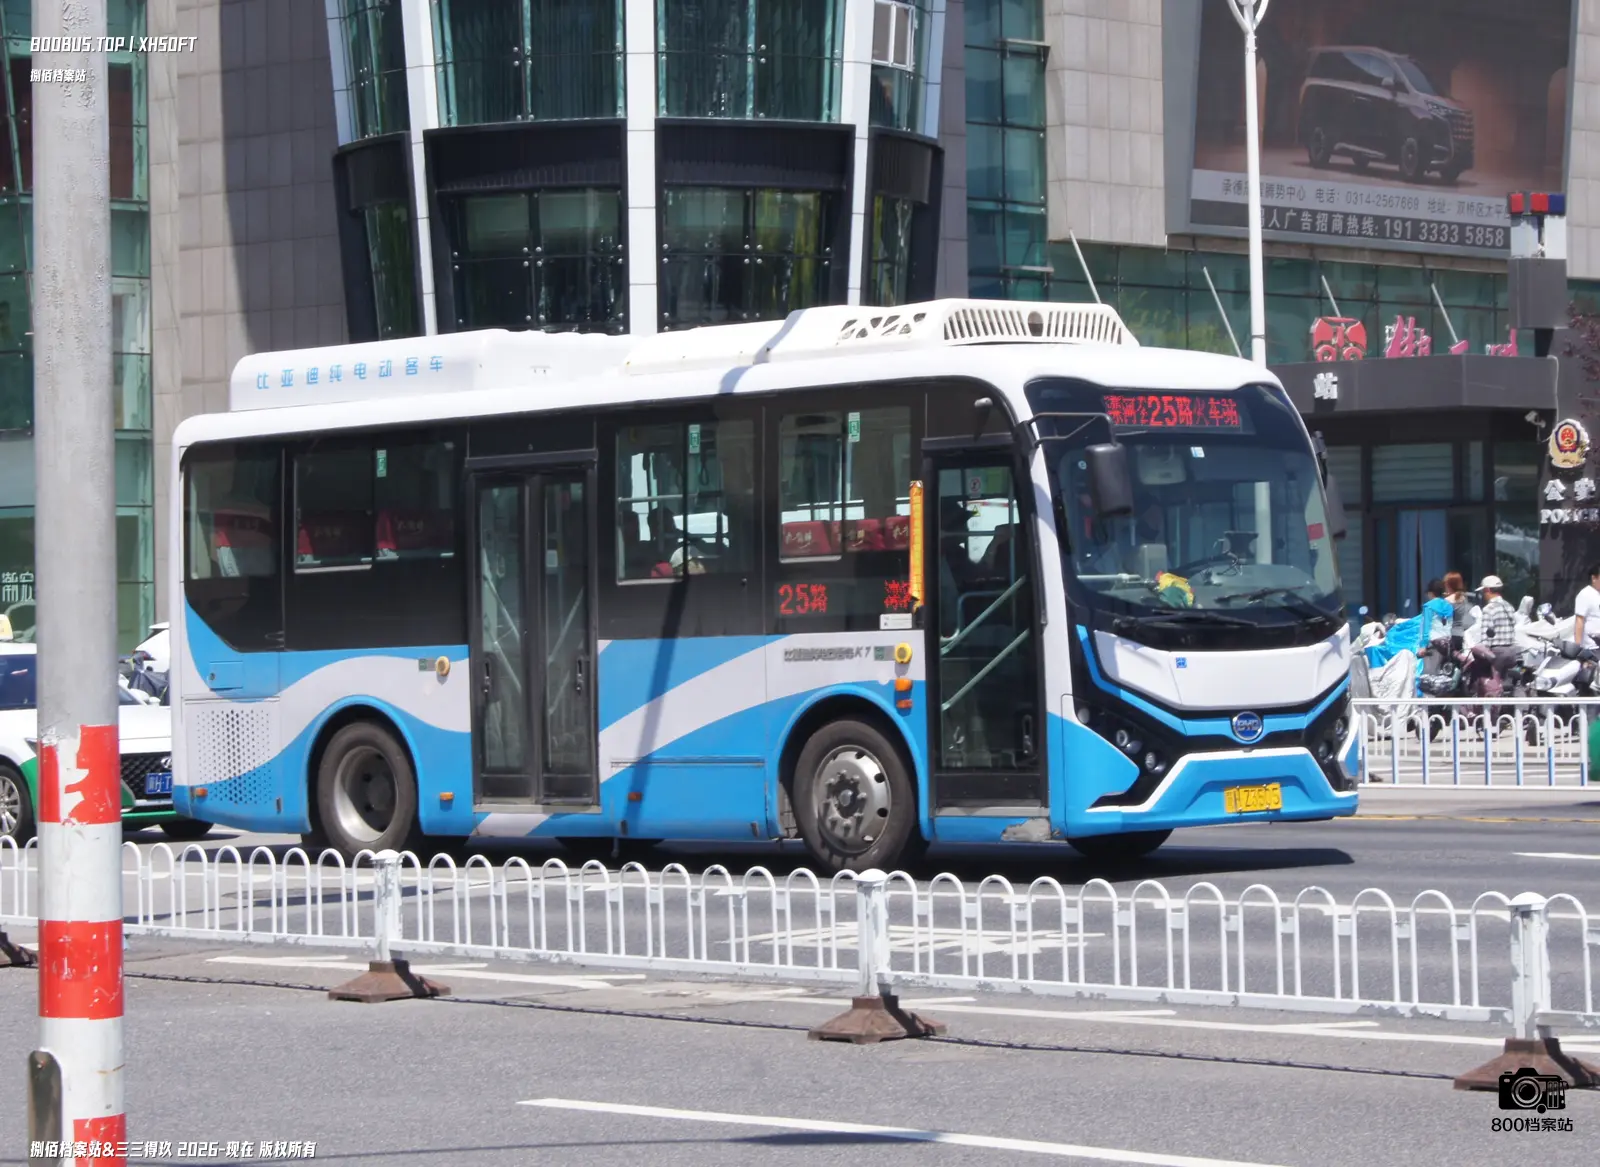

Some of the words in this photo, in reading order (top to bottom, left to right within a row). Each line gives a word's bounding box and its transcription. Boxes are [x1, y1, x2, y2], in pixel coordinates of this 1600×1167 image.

[1222, 179, 1306, 201] 承德腾势中心
[1384, 218, 1412, 240] 191
[1418, 222, 1459, 243] 3333
[1465, 226, 1505, 247] 5858
[256, 355, 444, 390] 比亚迪纯电动客车
